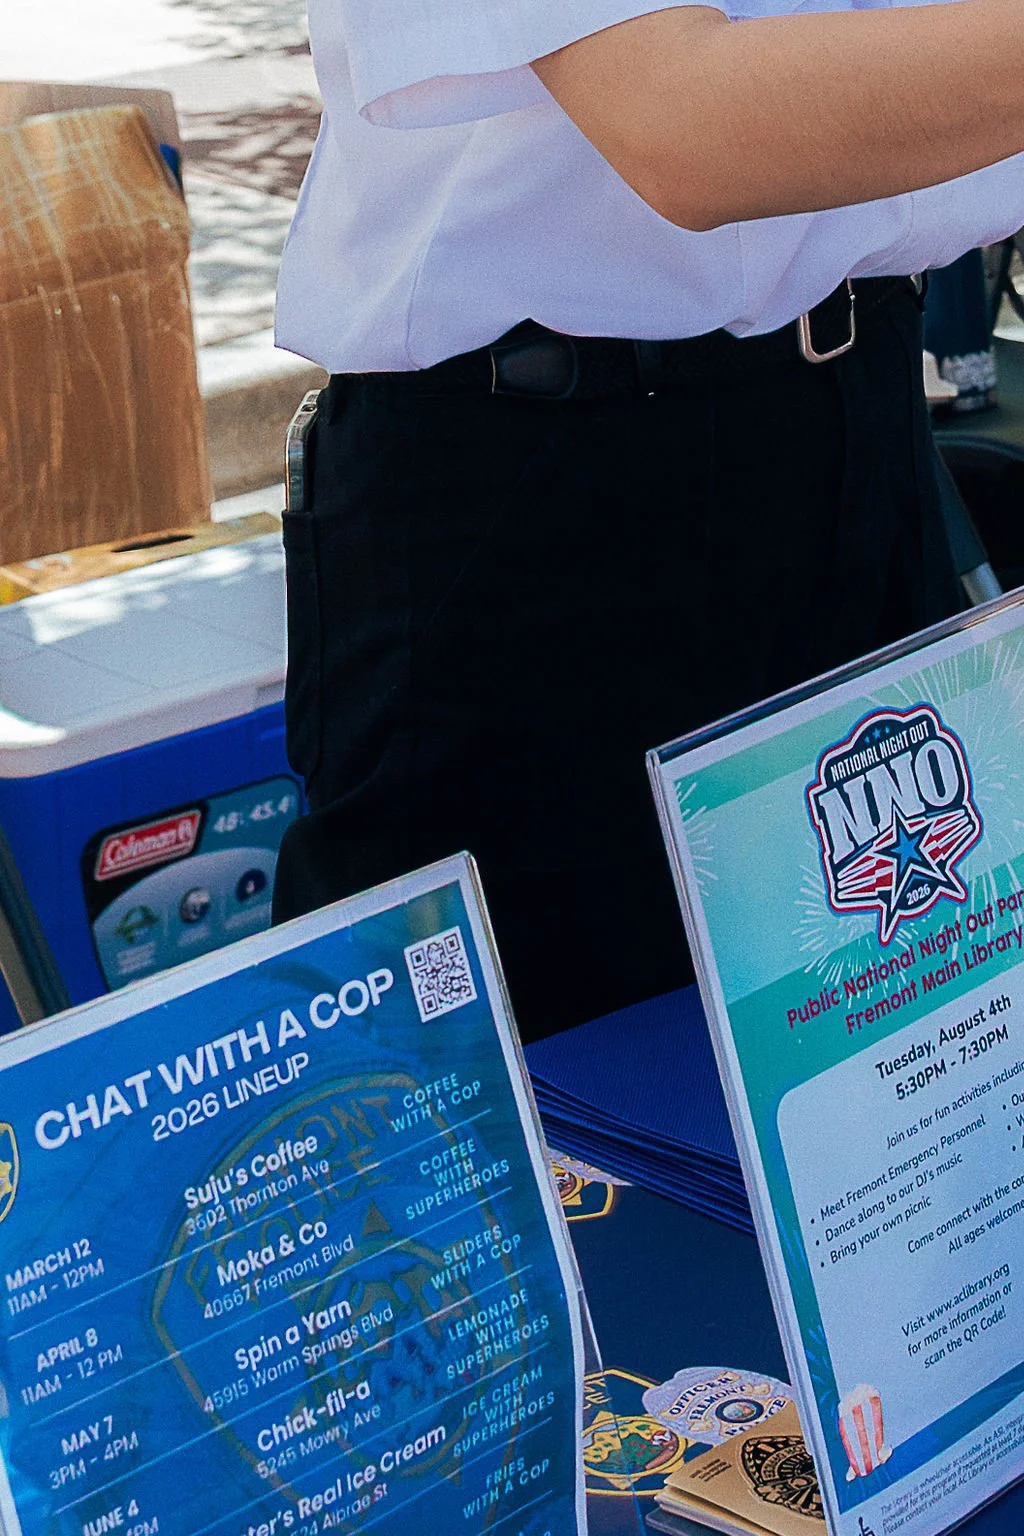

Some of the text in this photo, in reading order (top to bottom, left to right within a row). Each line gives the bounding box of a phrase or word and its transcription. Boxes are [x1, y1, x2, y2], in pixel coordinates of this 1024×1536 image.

[830, 719, 930, 783] NATIONAL NIGHT OUT
[817, 738, 960, 865] NNO
[906, 882, 932, 906] 2026
[787, 986, 842, 1031] Public
[842, 944, 918, 1000] National
[917, 919, 964, 960] Night
[965, 901, 996, 933] Out
[845, 925, 1024, 1036] Fremont Main Library
[34, 967, 395, 1151] CHAT WITH A COP
[875, 993, 1013, 1081] Tuesday, August 4th
[895, 1023, 1011, 1102] 5:30PM 7:30PM
[150, 1051, 310, 1142] 2026 LINEUP
[390, 1080, 482, 1134] WITH COP
[402, 1072, 460, 1110] COFFEE
[886, 1130, 907, 1151] Join
[934, 1104, 952, 1123] fun
[952, 1082, 993, 1112] activities
[183, 1134, 318, 1210] Suju's Coffee
[418, 1137, 477, 1176] COFFEE
[433, 1157, 475, 1188] WITH
[819, 1114, 987, 1223] Meet Fremont Emergency Personnel
[229, 1172, 299, 1215] Thornton
[405, 1158, 511, 1221] SUPERHEROES
[824, 1151, 964, 1243] Dance along our music
[907, 1231, 936, 1255] Come
[935, 1207, 973, 1239] connect
[971, 1193, 995, 1214] with
[993, 1182, 1012, 1202] the
[216, 1220, 328, 1287] Moka & Co
[430, 1234, 522, 1291] WITH COP
[442, 1224, 503, 1266] SLIDERS
[829, 1195, 933, 1265] Bring your own picnic
[948, 1235, 965, 1255] All
[962, 1222, 987, 1247] ages
[4, 1237, 93, 1293] MARCH 12
[7, 1257, 106, 1317] 11AM 12PM
[203, 1233, 355, 1320] 40667 Fremont Blvd
[447, 1288, 530, 1342] LEMONADE
[474, 1314, 516, 1346] WITH
[901, 1263, 1012, 1338] Visit www.aclibrary.org
[906, 1289, 1003, 1358] for more information
[36, 1336, 85, 1374] APRIL
[203, 1302, 395, 1414] 45915 Warm Springs Blvd
[234, 1299, 353, 1372] Spin Yarn
[445, 1314, 550, 1380] SUPERHEROES
[924, 1304, 1008, 1370] scan Code!
[20, 1373, 63, 1406] 11AM
[256, 1379, 371, 1453] Chick-fil-a
[461, 1364, 544, 1421] ICE CREAM
[483, 1391, 524, 1424] WITH
[59, 1421, 101, 1457] MAY
[299, 1403, 383, 1459] Mowry Ave
[452, 1390, 556, 1458] SUPERHEROES
[48, 1430, 141, 1491] 3PM 4PM
[297, 1424, 447, 1520] Real Ice Cream
[462, 1457, 550, 1520] WITH COP
[486, 1456, 526, 1490] FRIES
